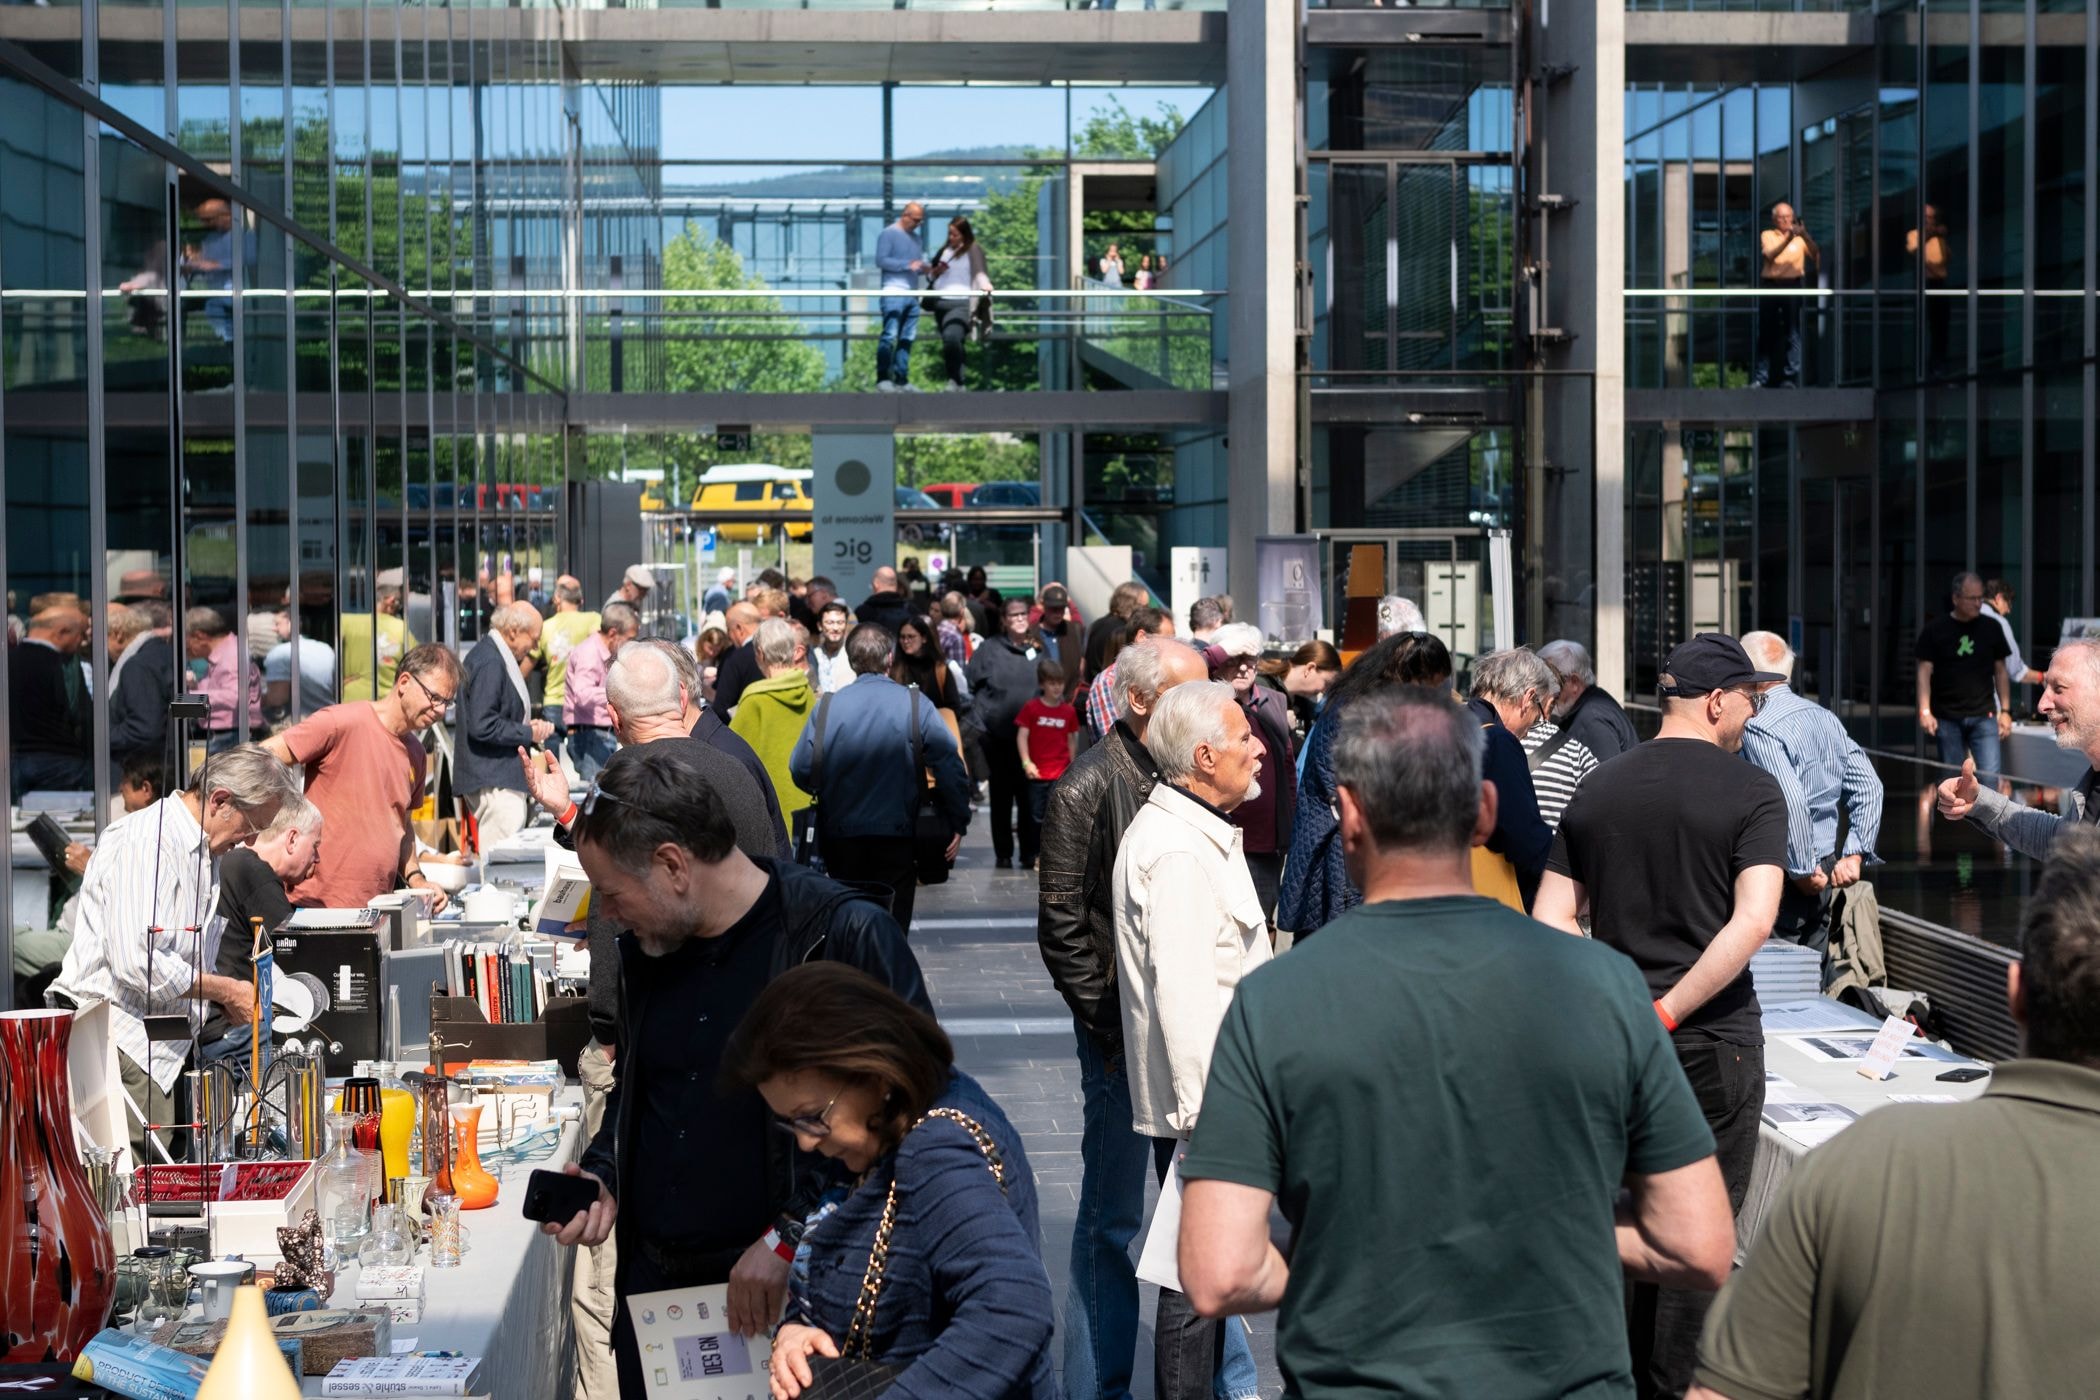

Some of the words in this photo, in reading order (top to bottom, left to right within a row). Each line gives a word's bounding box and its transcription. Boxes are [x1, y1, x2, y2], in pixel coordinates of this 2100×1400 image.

[276, 937, 297, 947] BRAUN
[97, 1361, 147, 1385] PRODUCT
[148, 1379, 186, 1399] DESIGN
[106, 1376, 126, 1389] THE
[328, 1382, 361, 1393] sessel
[362, 1382, 374, 1394] &
[375, 1382, 406, 1393] stühle
